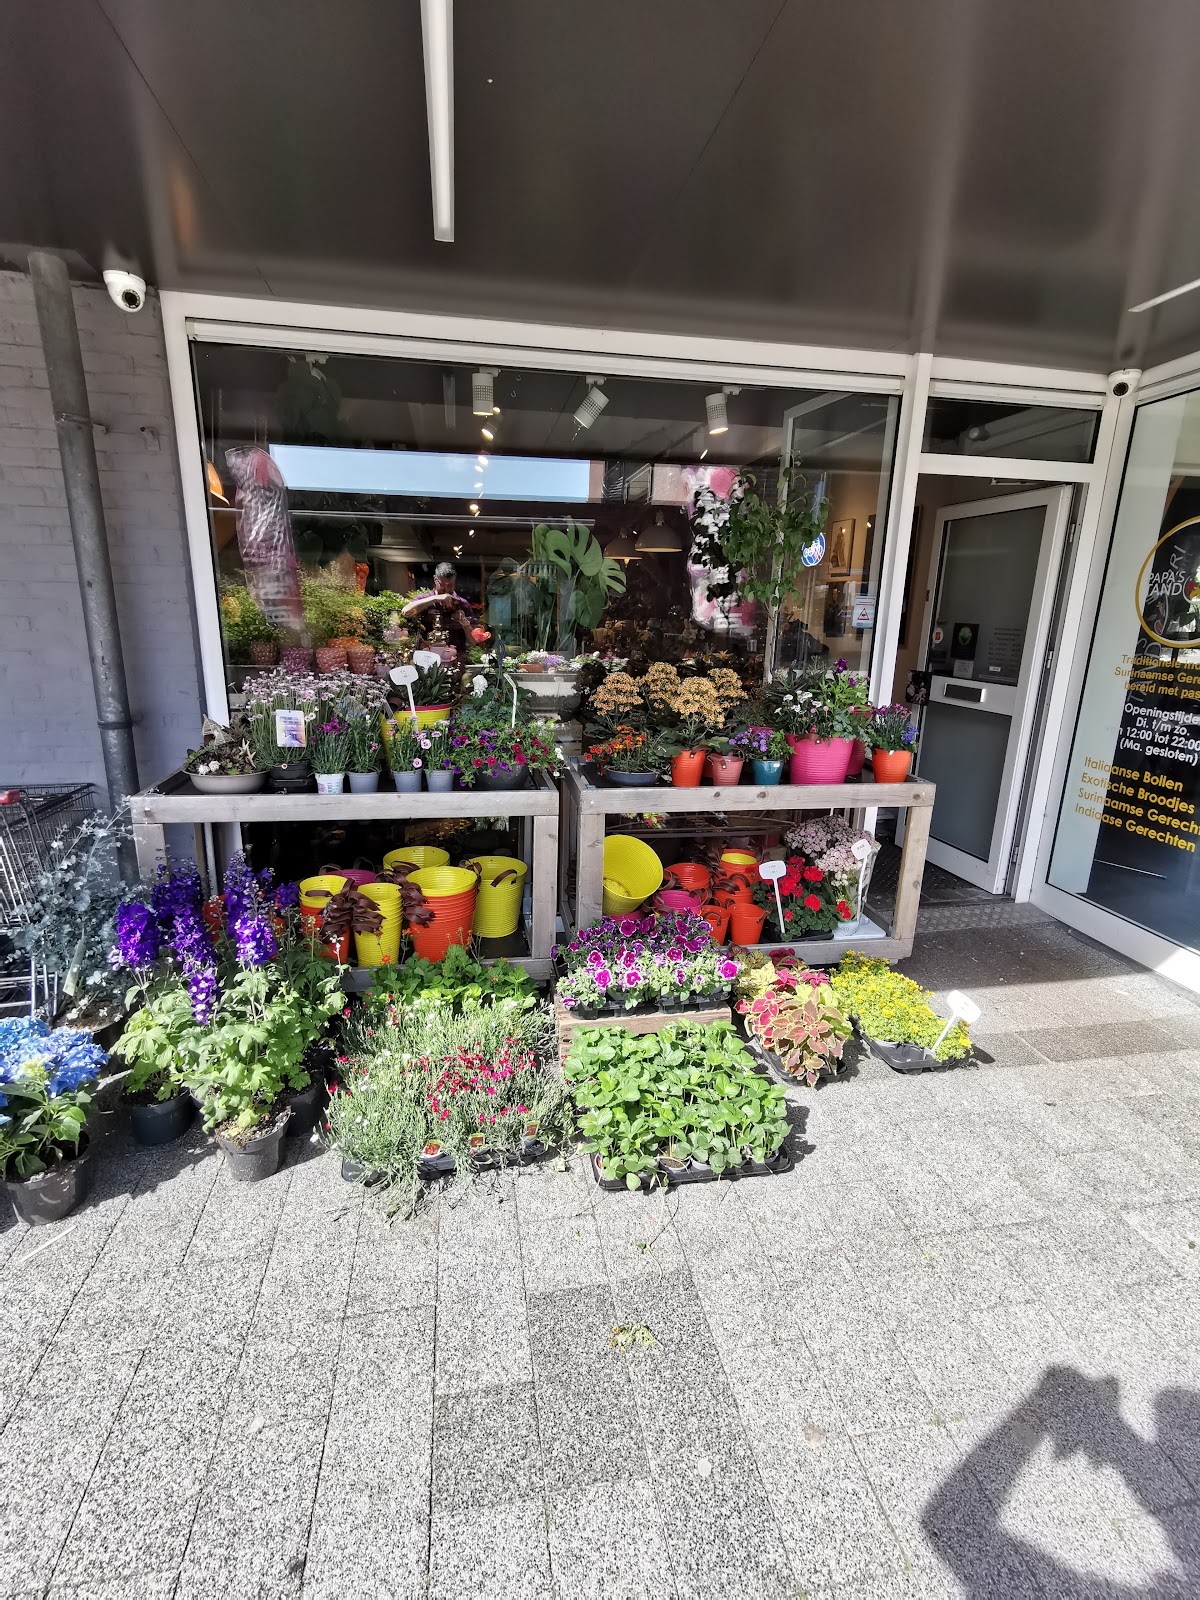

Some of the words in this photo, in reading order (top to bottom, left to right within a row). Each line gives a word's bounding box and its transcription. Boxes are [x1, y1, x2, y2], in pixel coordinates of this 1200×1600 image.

[1114, 667, 1174, 681] Surinaamse
[1122, 654, 1181, 669] Traditionele
[1124, 681, 1156, 693] bereid
[1157, 685, 1179, 696] met
[1126, 727, 1153, 741] 12:00
[1154, 732, 1170, 744] tot
[1170, 736, 1200, 751] 22:00
[1136, 717, 1149, 729] Di.
[1152, 719, 1172, 732] t/m
[1173, 725, 1190, 736] zo.
[1120, 737, 1143, 752] (Ma.
[1145, 745, 1198, 766] gesloten)
[1084, 756, 1140, 780] Italiaanse
[1143, 771, 1184, 792] Bollen
[1081, 772, 1135, 796] Exotische
[1137, 787, 1196, 814] Broodjes
[1078, 787, 1144, 817] Surinaamse
[1147, 809, 1200, 836] Gerech
[1075, 803, 1123, 827] Indiaase
[1125, 819, 1197, 853] Gerechten
